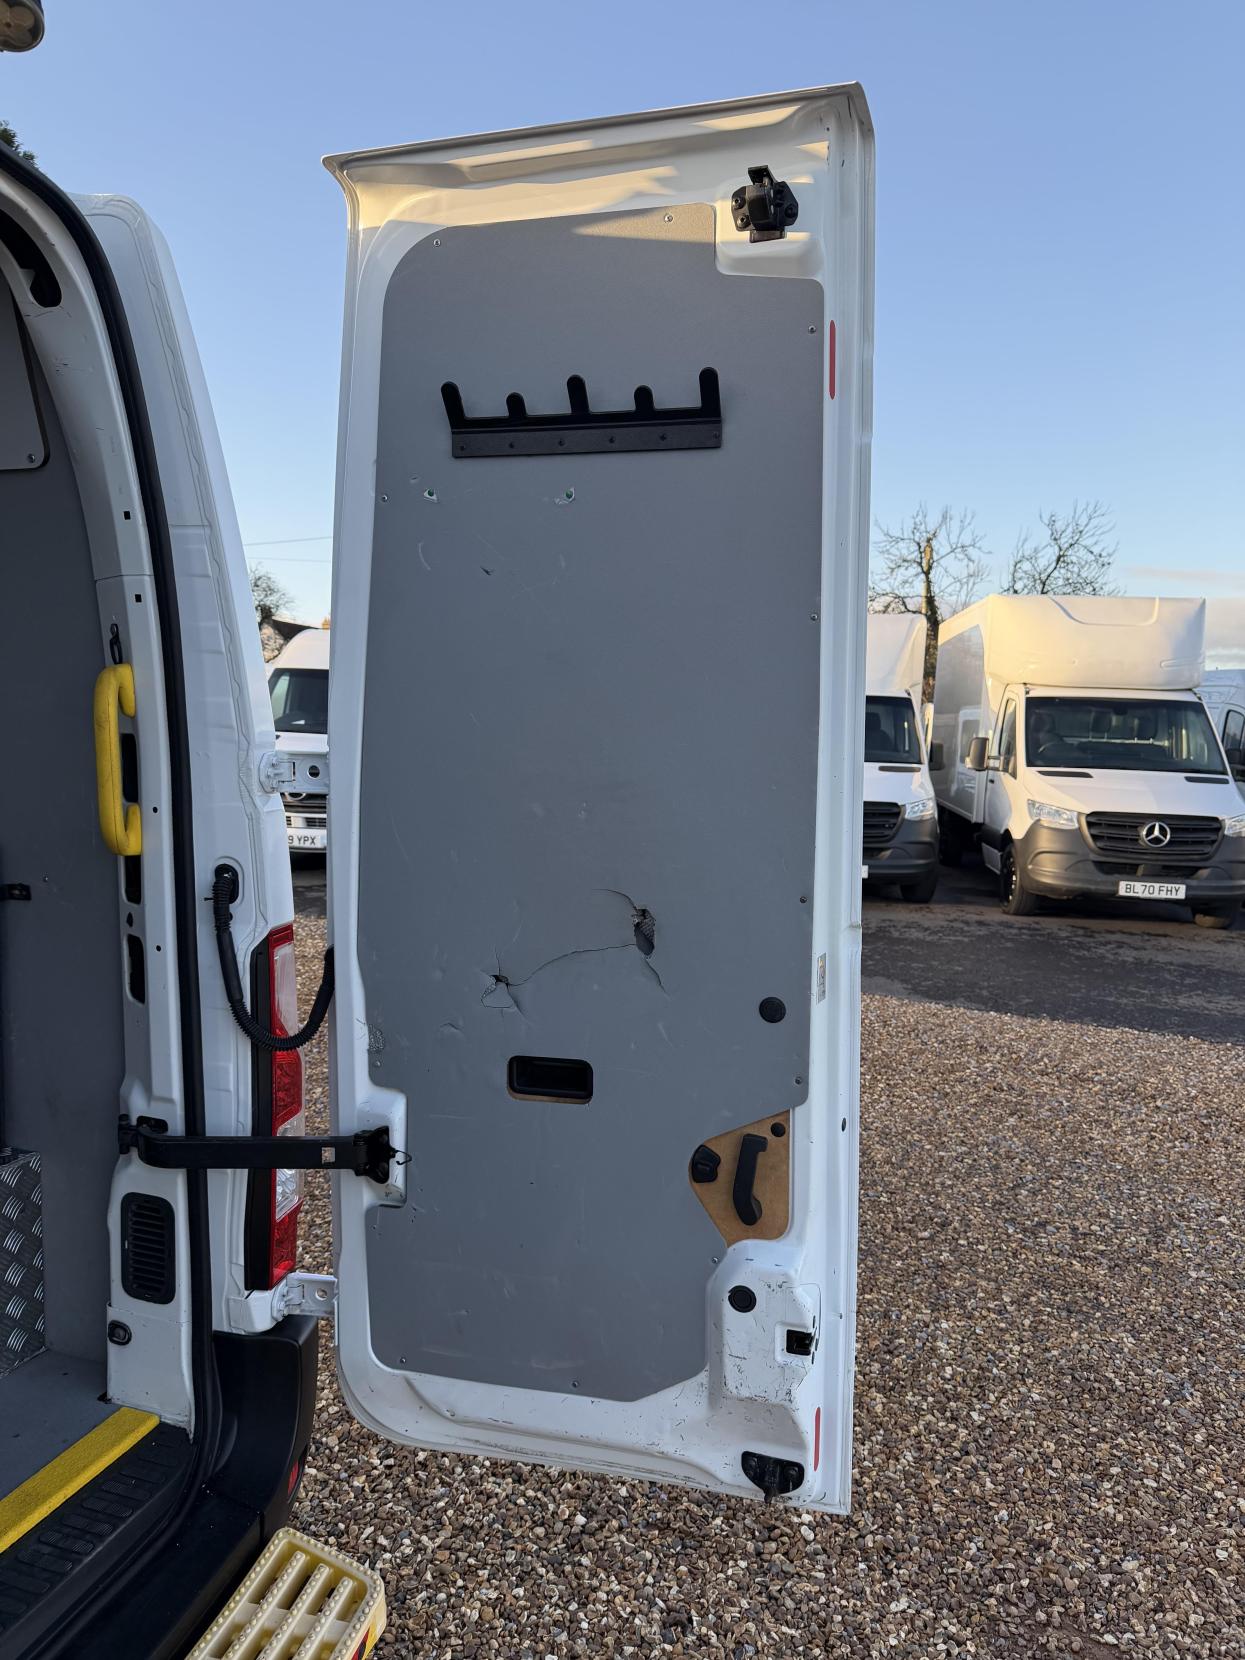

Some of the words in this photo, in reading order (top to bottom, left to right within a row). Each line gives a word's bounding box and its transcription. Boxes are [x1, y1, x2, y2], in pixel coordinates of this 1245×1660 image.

[297, 835, 316, 845] YPX
[1125, 883, 1155, 895] BL70
[1158, 885, 1180, 897] FHY
